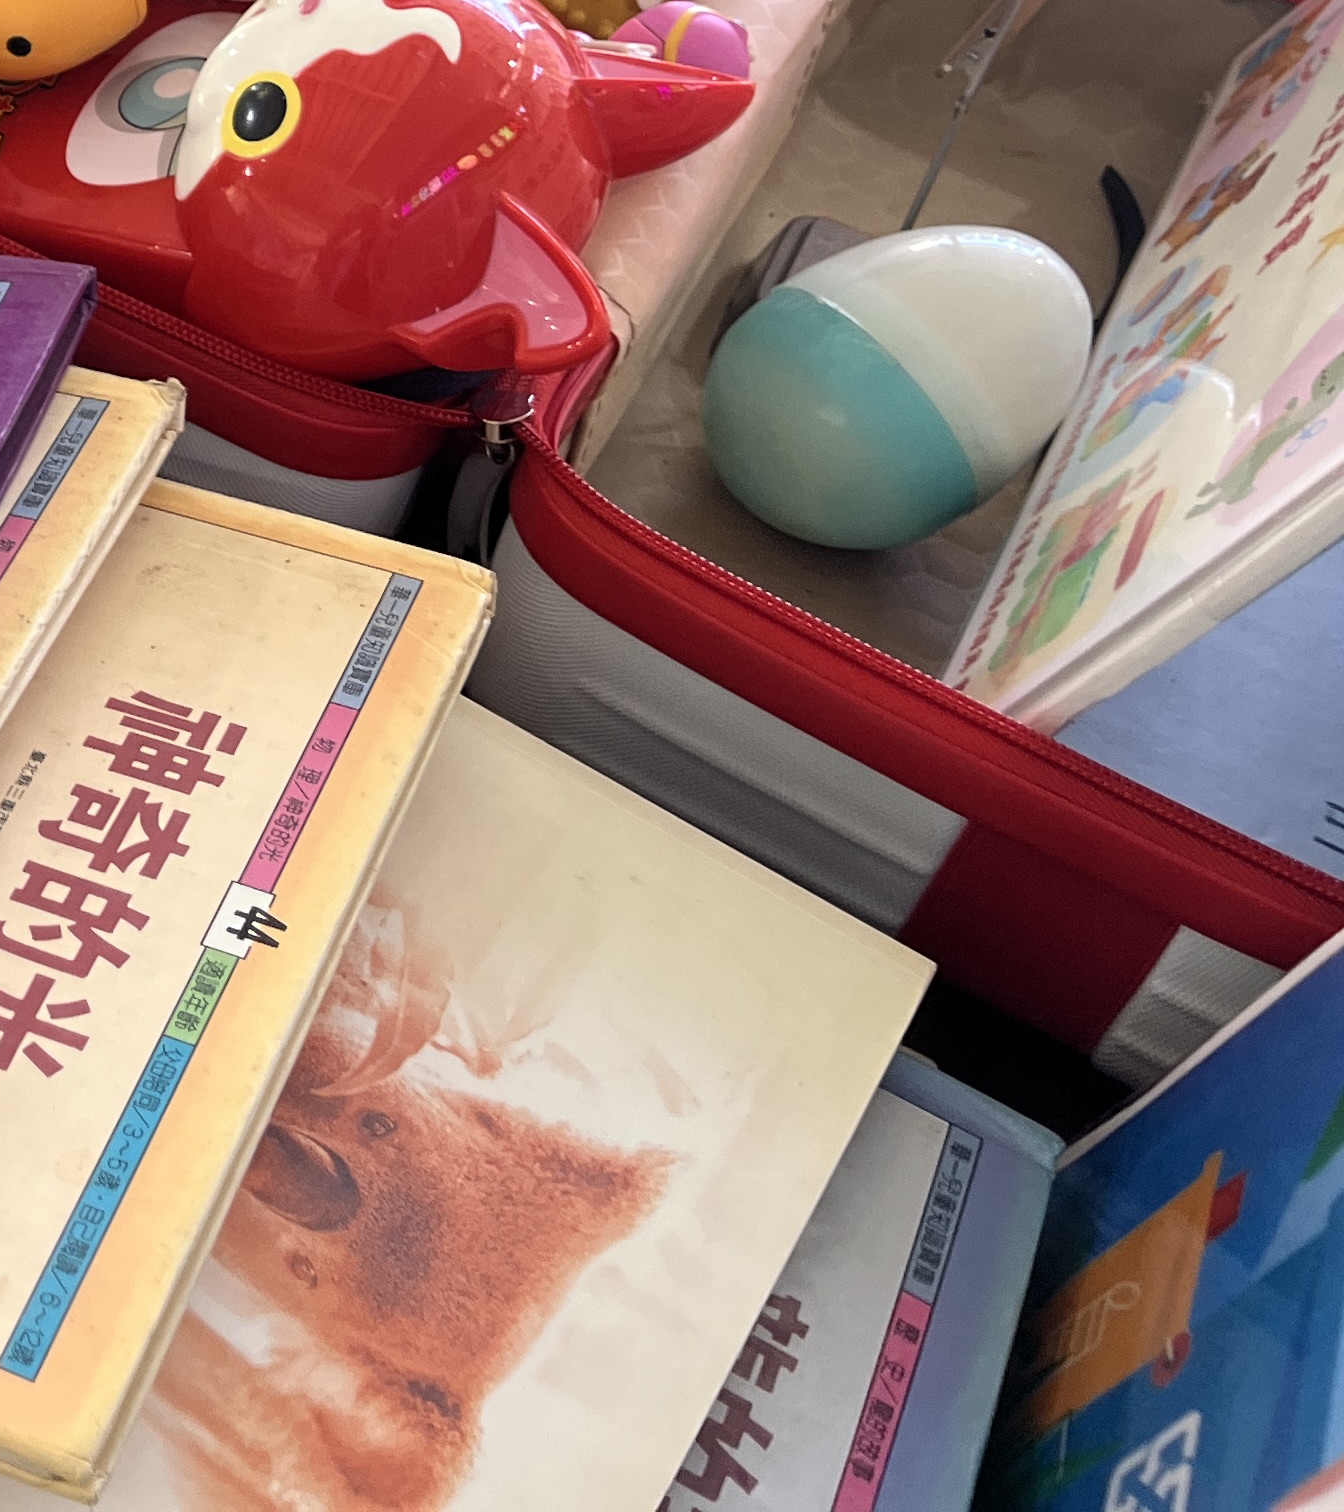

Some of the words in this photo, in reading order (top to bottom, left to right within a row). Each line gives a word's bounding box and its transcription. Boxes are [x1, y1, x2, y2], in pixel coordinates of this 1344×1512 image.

[341, 585, 412, 698] 華一兒童知識寶庫
[226, 906, 288, 948] 44
[174, 958, 226, 1034] 適讀年齡
